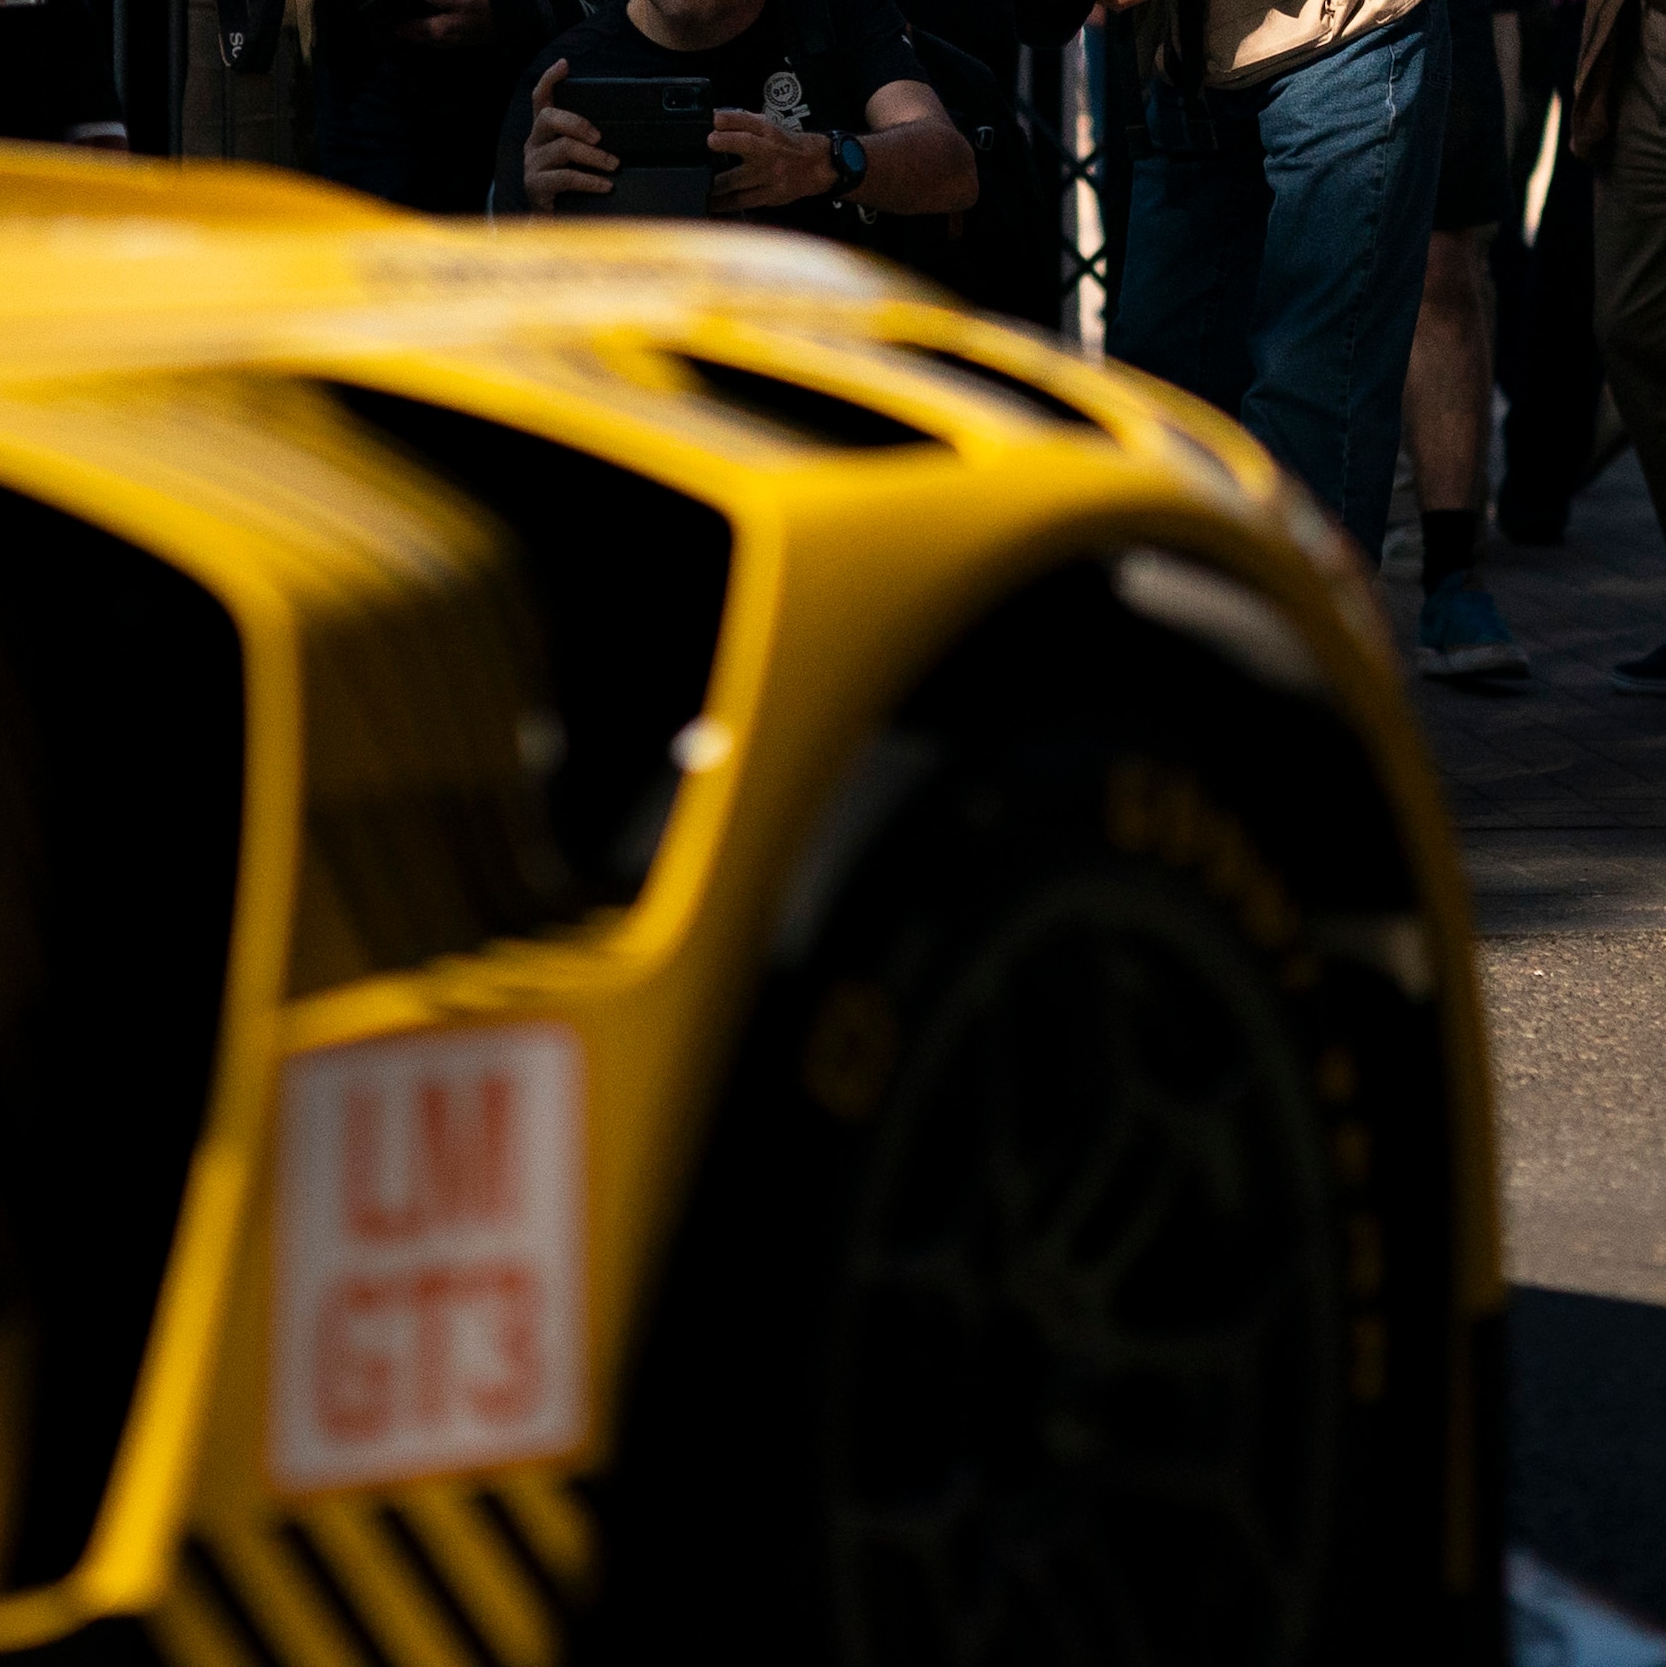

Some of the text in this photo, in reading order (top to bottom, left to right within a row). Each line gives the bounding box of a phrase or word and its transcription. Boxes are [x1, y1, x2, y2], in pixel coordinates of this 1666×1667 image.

[773, 84, 790, 97] 917
[343, 1075, 521, 1238] LM
[315, 1263, 548, 1438] GT3
